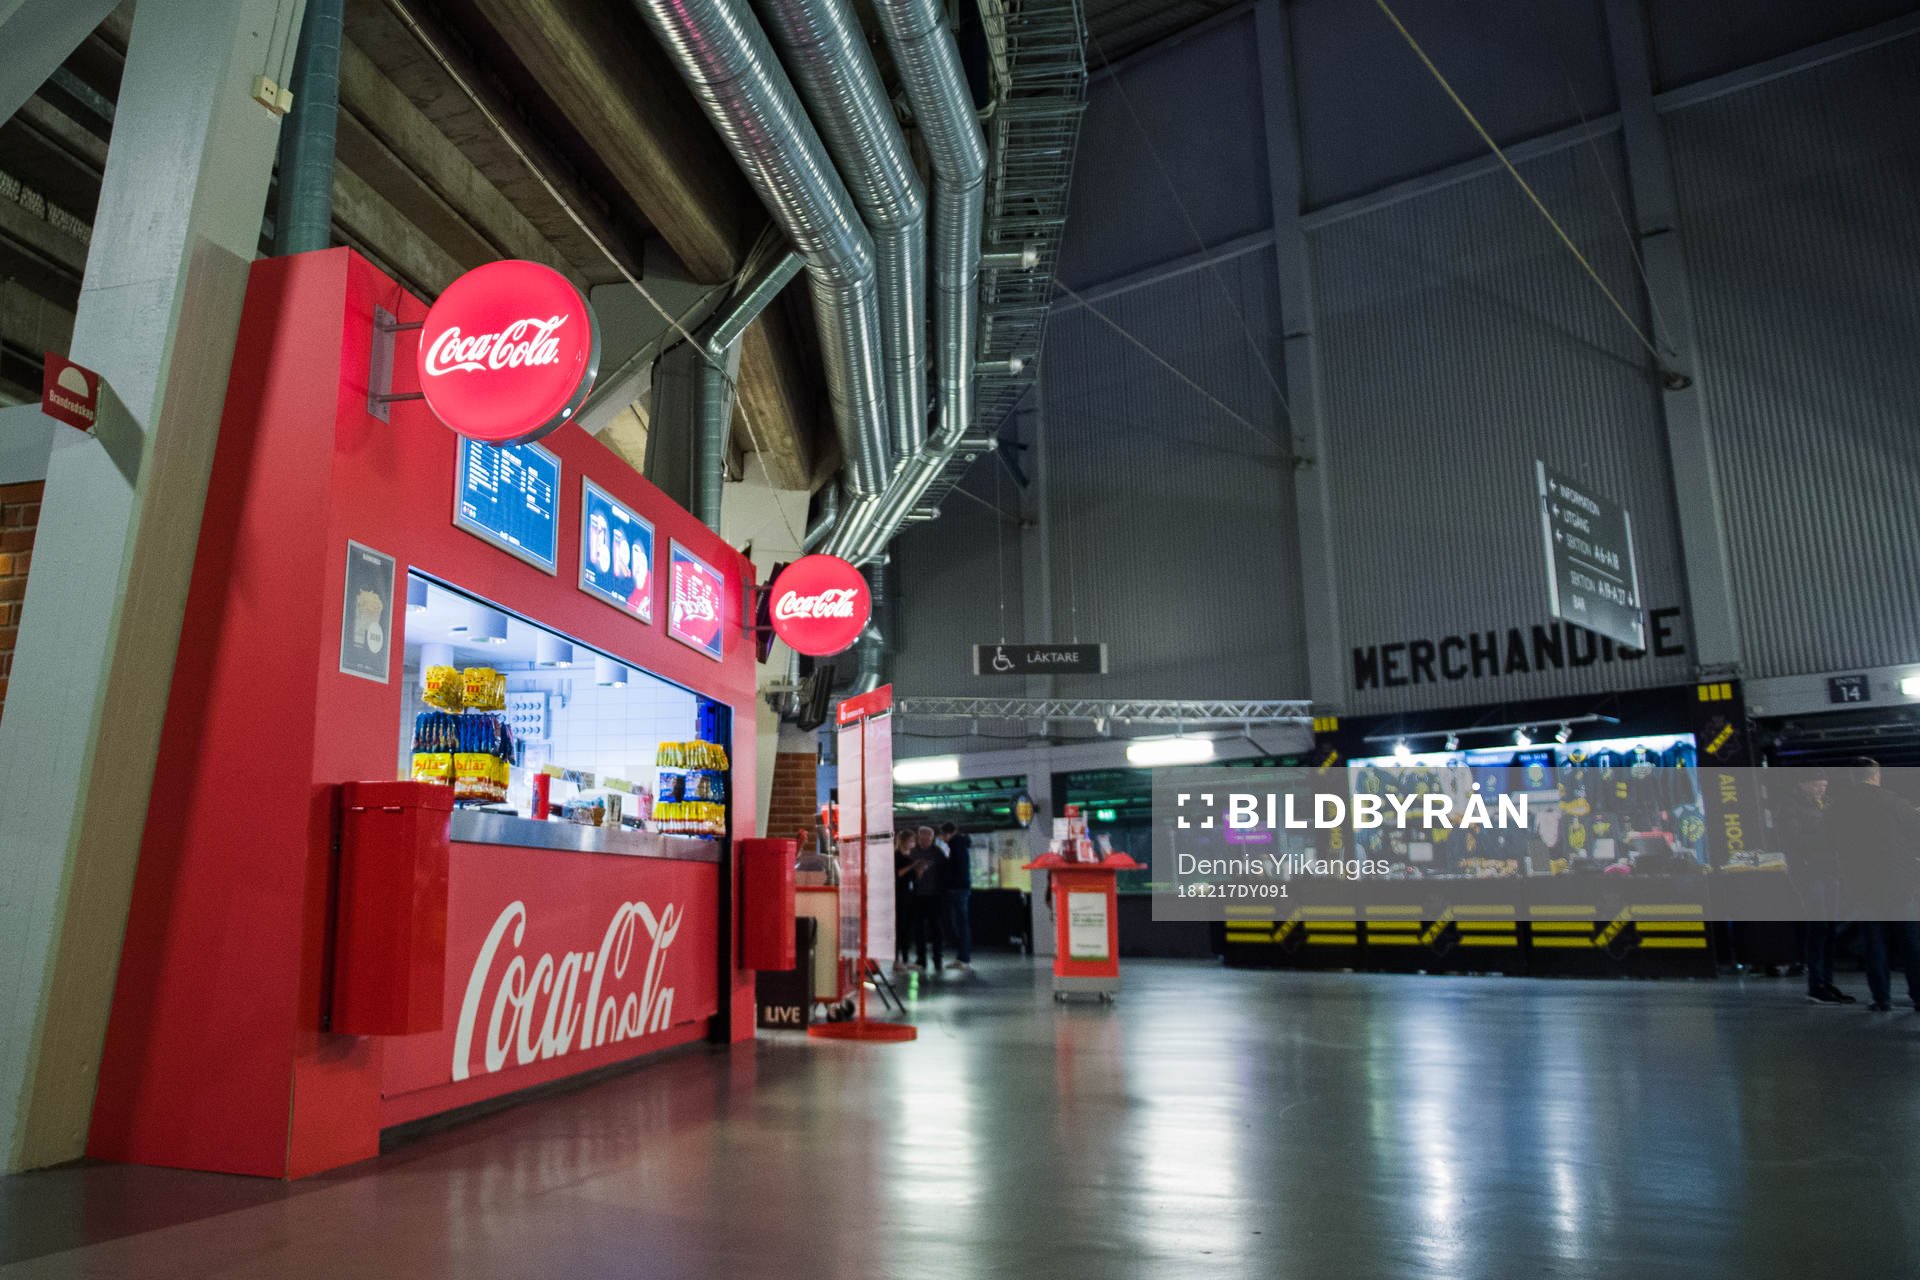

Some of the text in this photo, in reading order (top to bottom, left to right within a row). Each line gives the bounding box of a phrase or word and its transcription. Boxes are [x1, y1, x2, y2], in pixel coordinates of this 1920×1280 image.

[425, 313, 569, 376] Coca-Cola
[49, 389, 95, 420] Brandredskap
[1559, 484, 1600, 516] INFORMATION
[775, 588, 859, 620] Coca-Cola
[1026, 651, 1080, 664] LÄKTARE
[1352, 607, 1686, 691] MERCHANDIE
[1840, 686, 1861, 701] 14
[1718, 773, 1745, 858] AIK HOC
[452, 900, 684, 1082] Coca-Cola
[764, 1005, 801, 1023] LIVE
